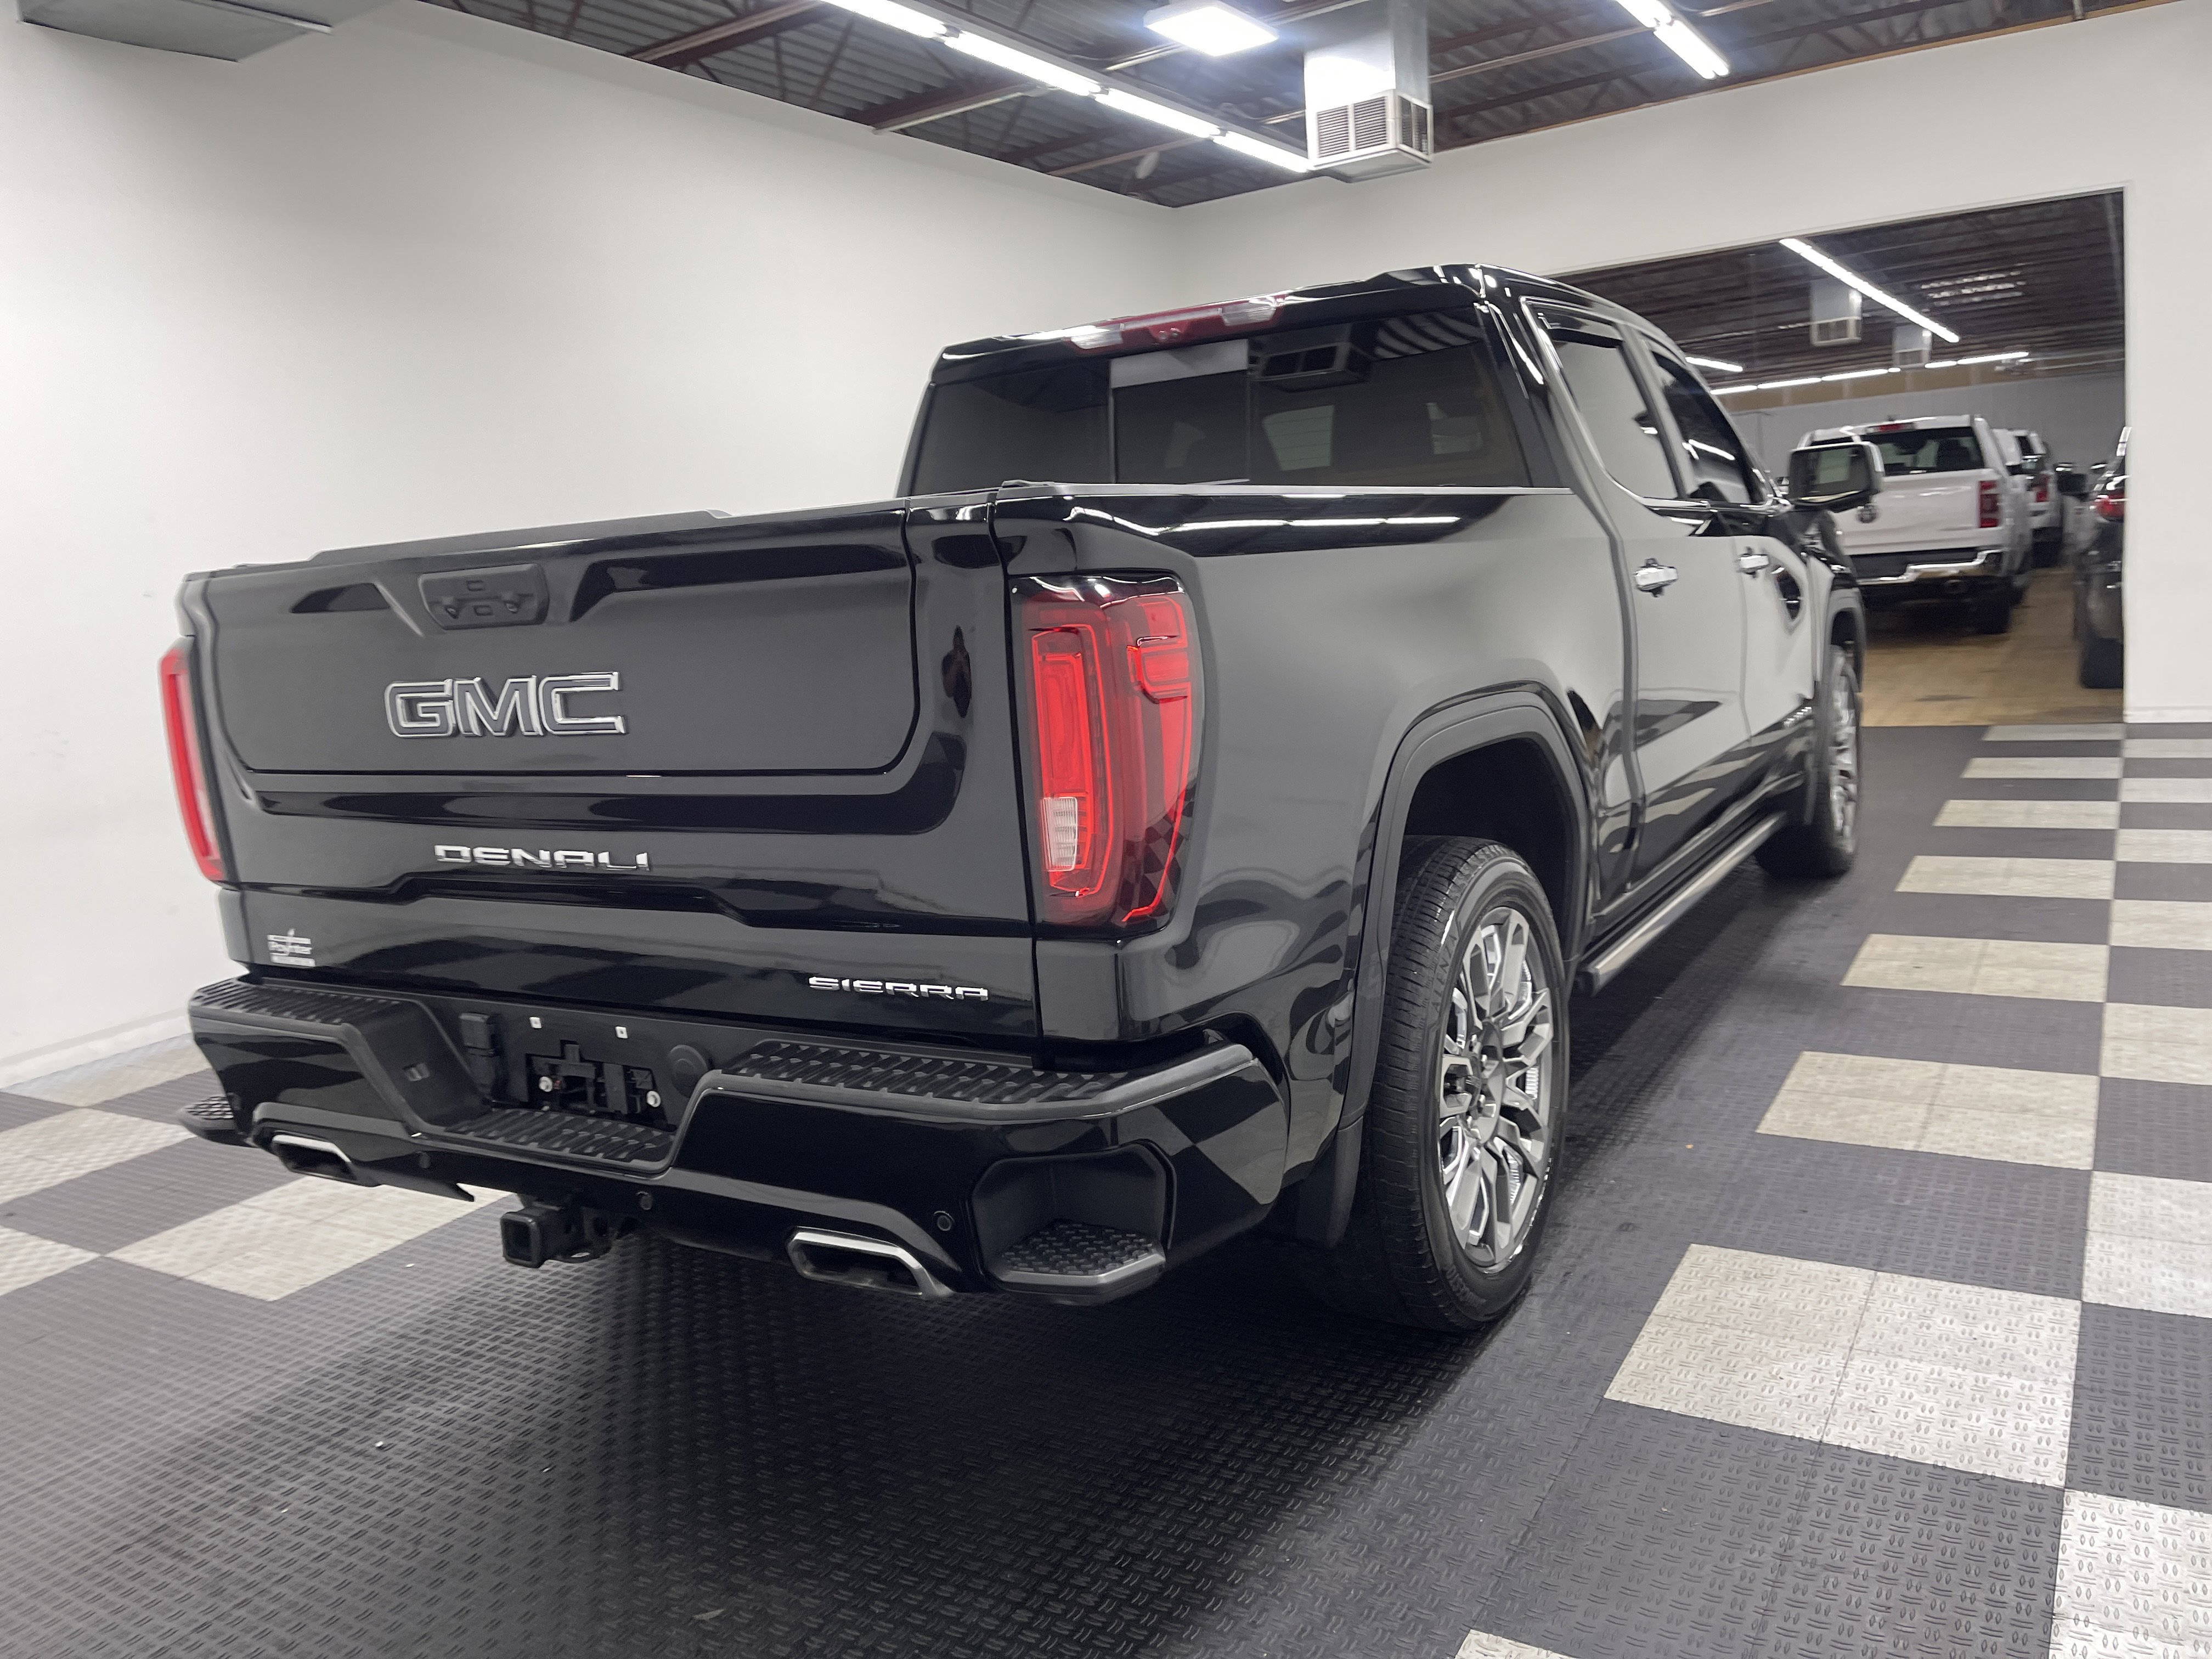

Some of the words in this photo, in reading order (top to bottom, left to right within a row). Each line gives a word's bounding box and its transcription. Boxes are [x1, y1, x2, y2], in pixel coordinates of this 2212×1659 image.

[385, 672, 626, 737] GMC
[435, 845, 651, 871] DENALI
[809, 977, 988, 1001] SIERRA
